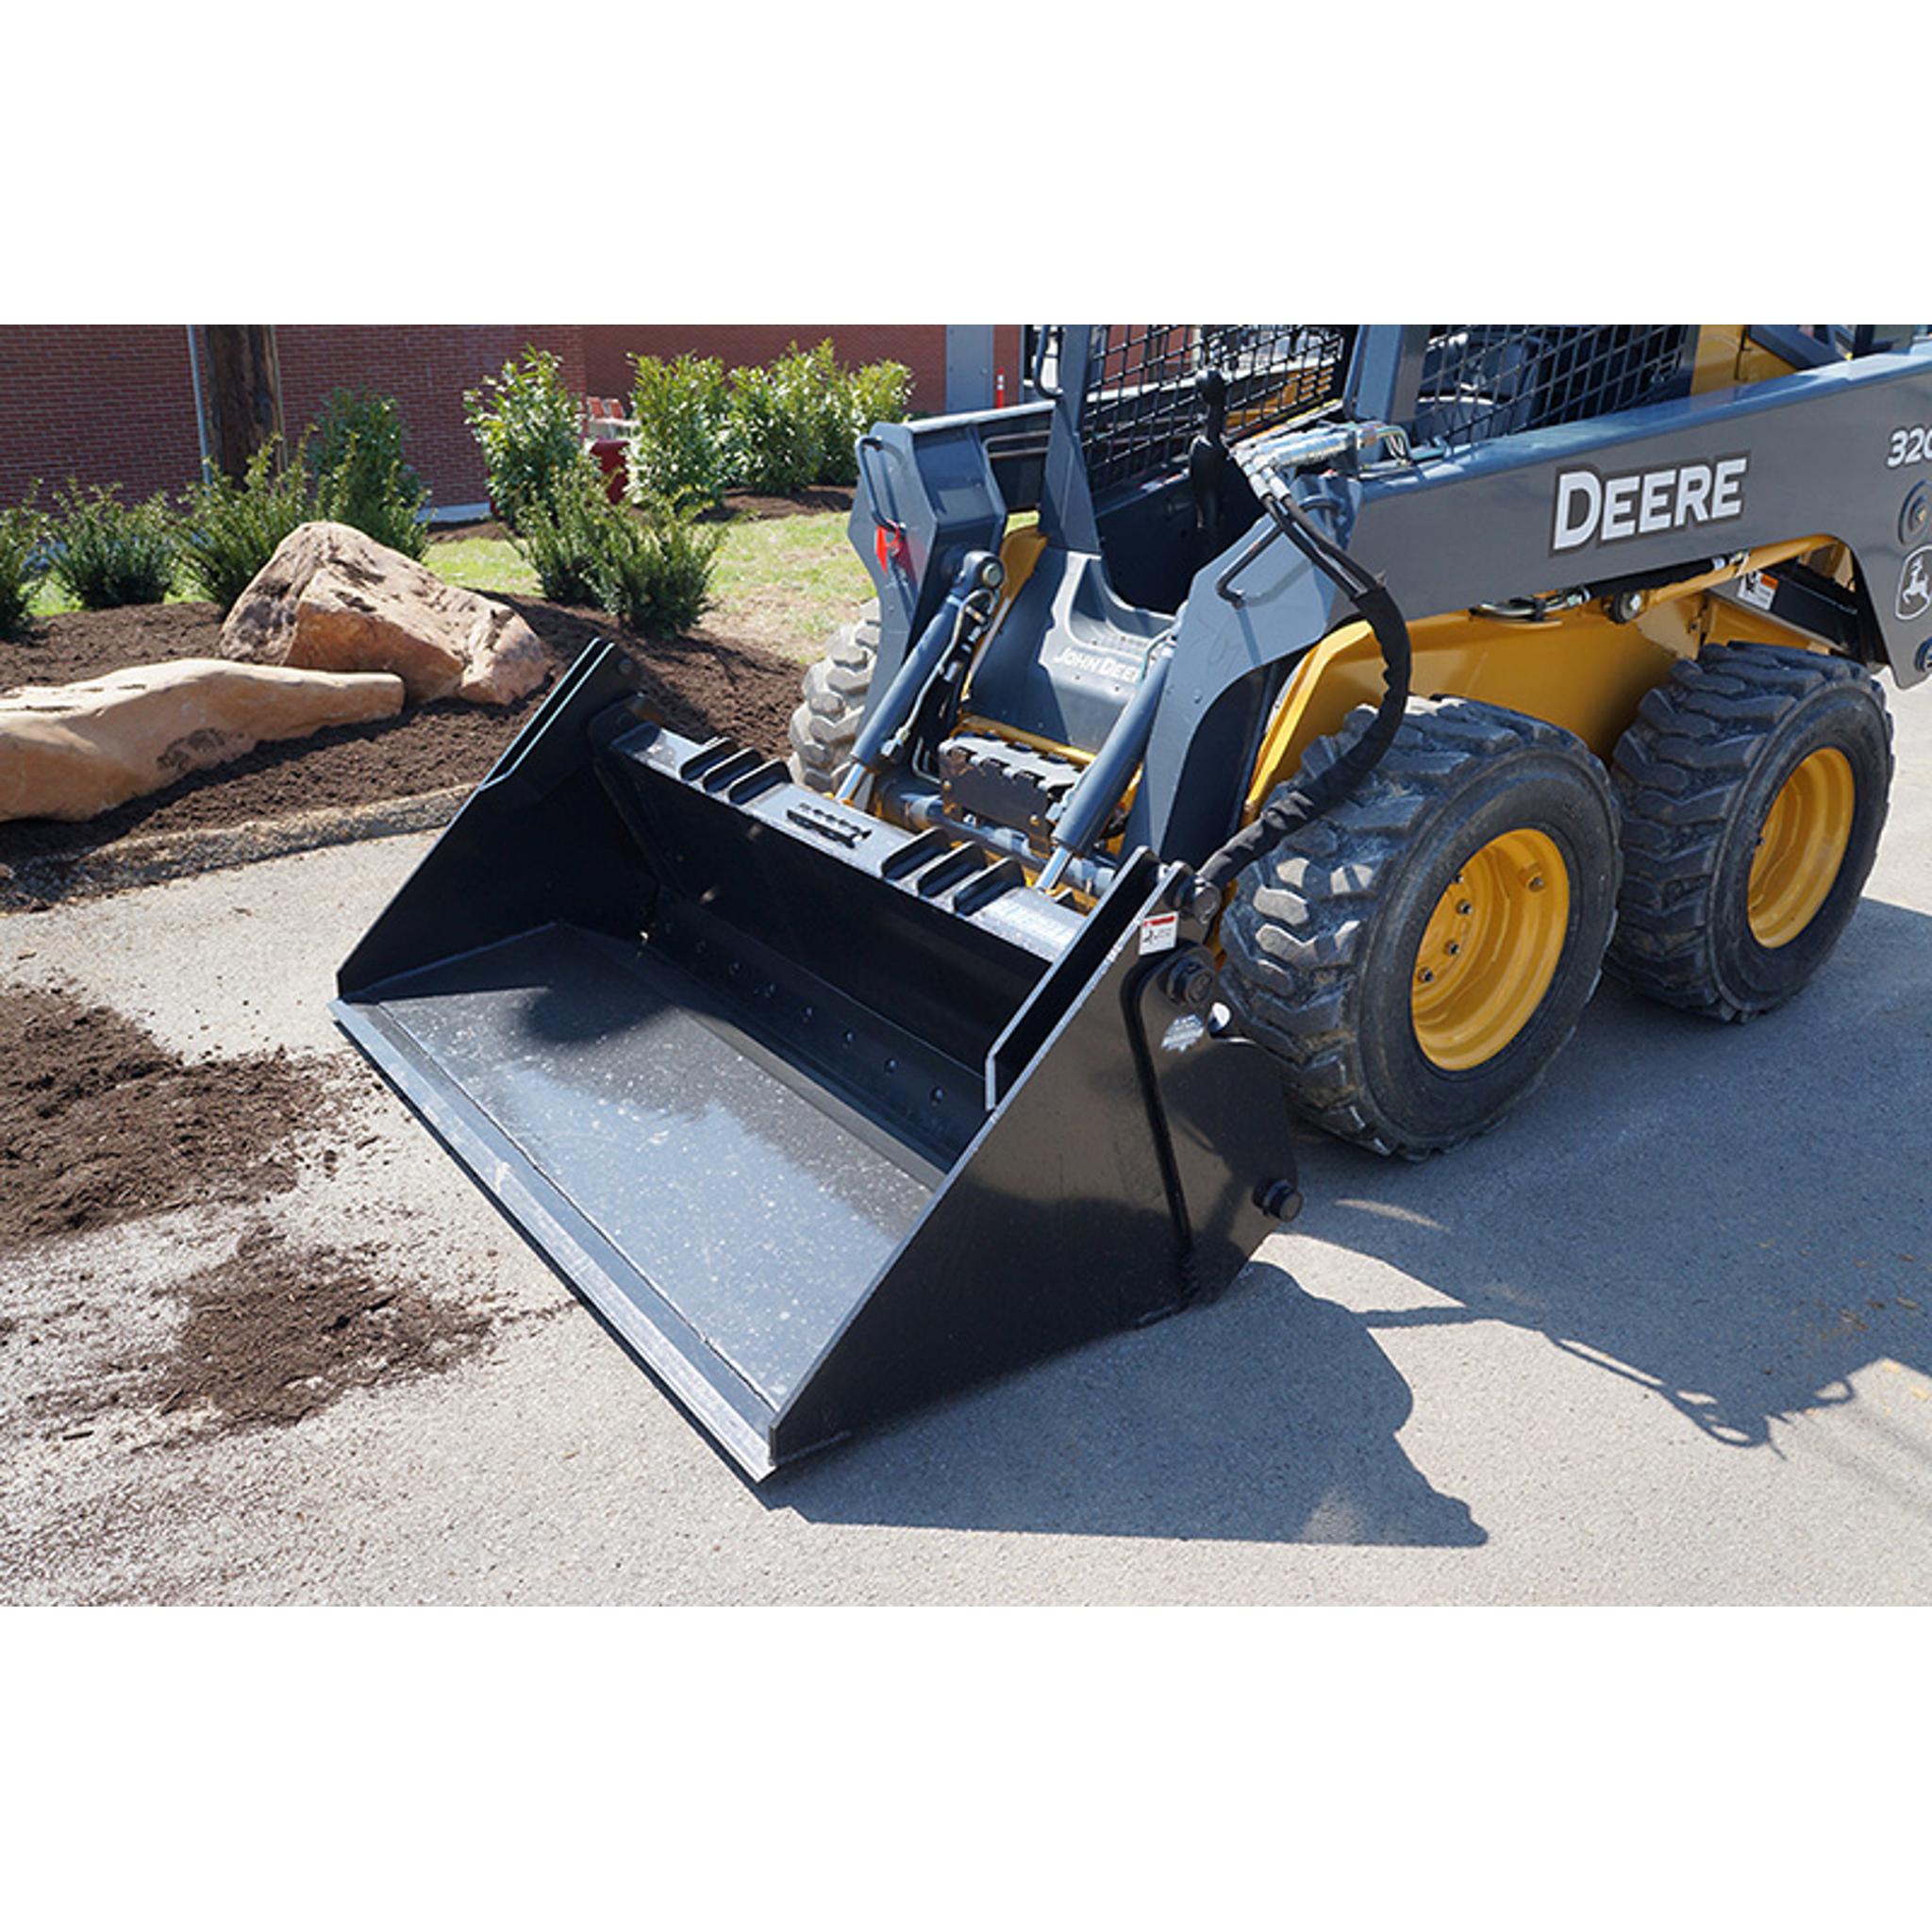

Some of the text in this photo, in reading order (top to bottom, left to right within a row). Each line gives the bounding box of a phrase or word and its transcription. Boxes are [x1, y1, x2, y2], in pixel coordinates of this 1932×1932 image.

[1553, 458, 1748, 550] DEERE
[1053, 647, 1140, 684] JOHN DEE
